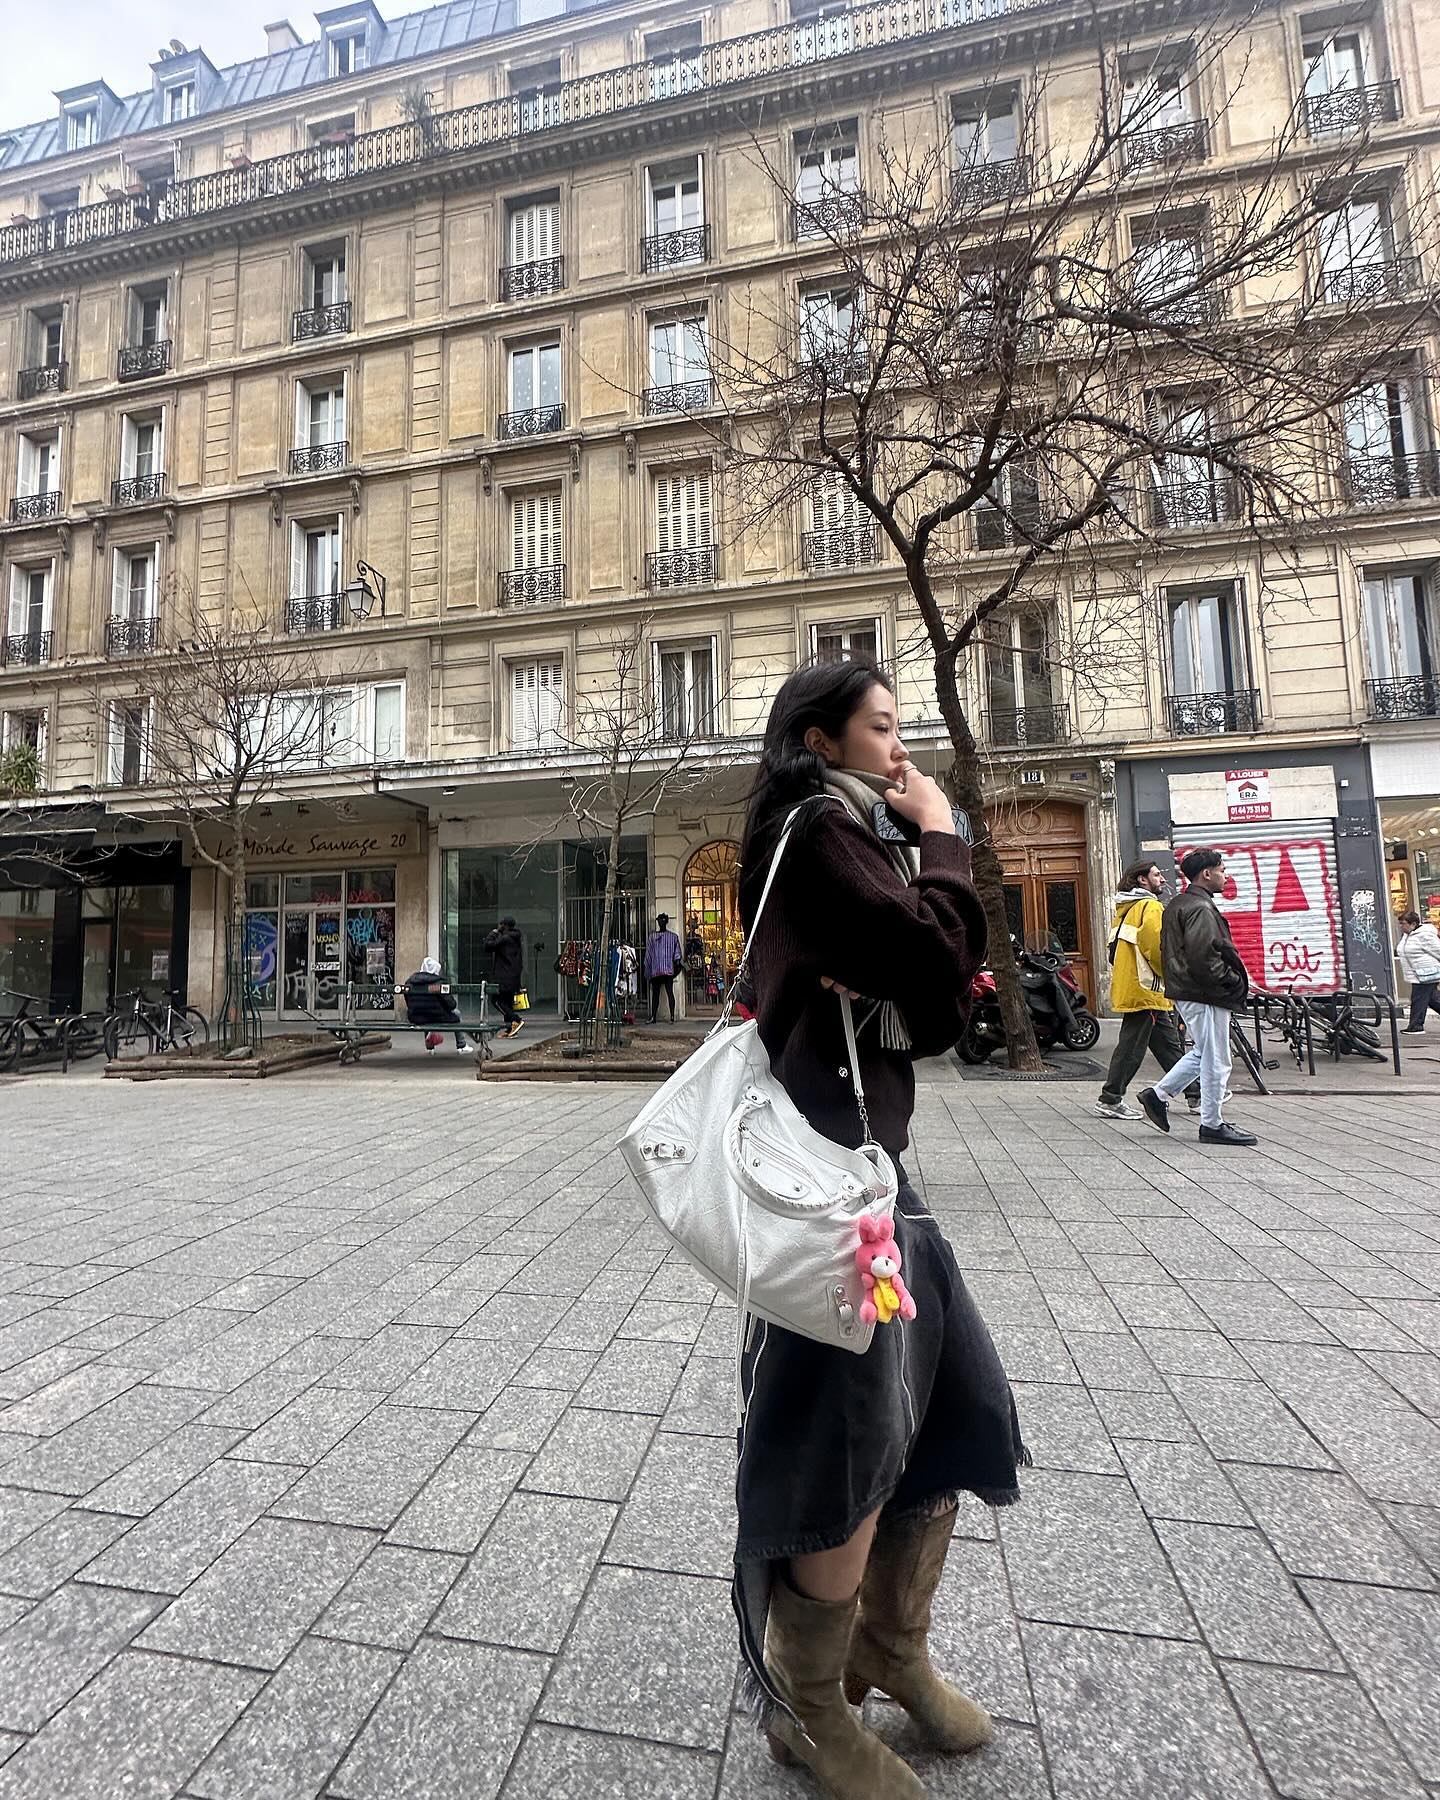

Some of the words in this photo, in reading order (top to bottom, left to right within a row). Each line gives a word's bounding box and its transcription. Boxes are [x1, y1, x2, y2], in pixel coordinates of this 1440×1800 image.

[1027, 771, 1038, 781] 18
[1230, 806, 1238, 815] 01
[1238, 806, 1247, 815] 44
[217, 839, 233, 859] Le
[243, 836, 297, 856] Monde
[307, 833, 381, 857] Sauvage
[391, 832, 407, 848] 20
